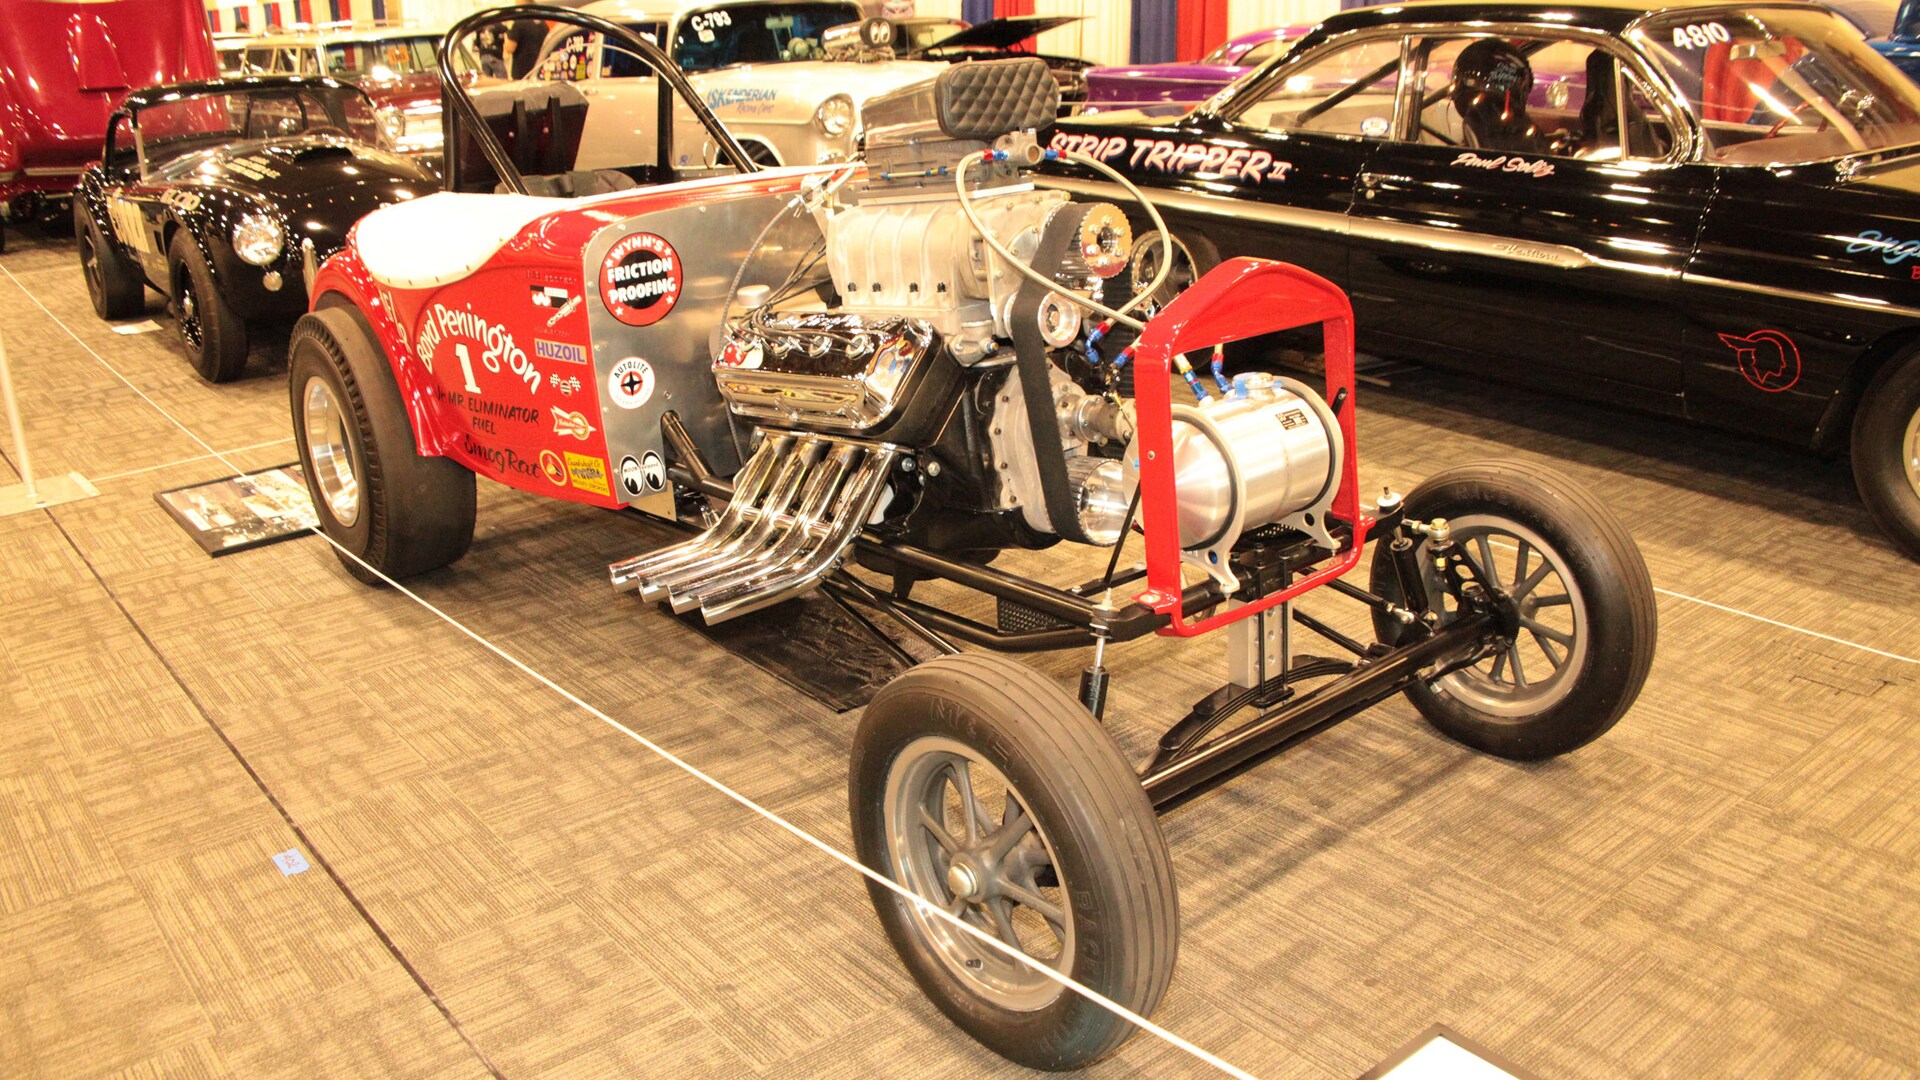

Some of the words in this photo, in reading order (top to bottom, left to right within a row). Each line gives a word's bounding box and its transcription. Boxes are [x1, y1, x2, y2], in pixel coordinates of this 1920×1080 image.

[1673, 21, 1730, 50] 4810
[1047, 132, 1127, 163] STRIP
[1130, 138, 1272, 184] TRIPPER
[1450, 152, 1507, 170] Paul
[610, 235, 664, 260] WYNN'S
[607, 257, 673, 284] FRICTION
[608, 277, 677, 305] PROOFING
[434, 302, 541, 395] Penington
[536, 341, 586, 363] HUZOIL
[455, 343, 482, 395] 1
[614, 361, 649, 379] AUTOLITE
[468, 397, 540, 426] ELIMINATOR
[472, 416, 497, 435] FUEL
